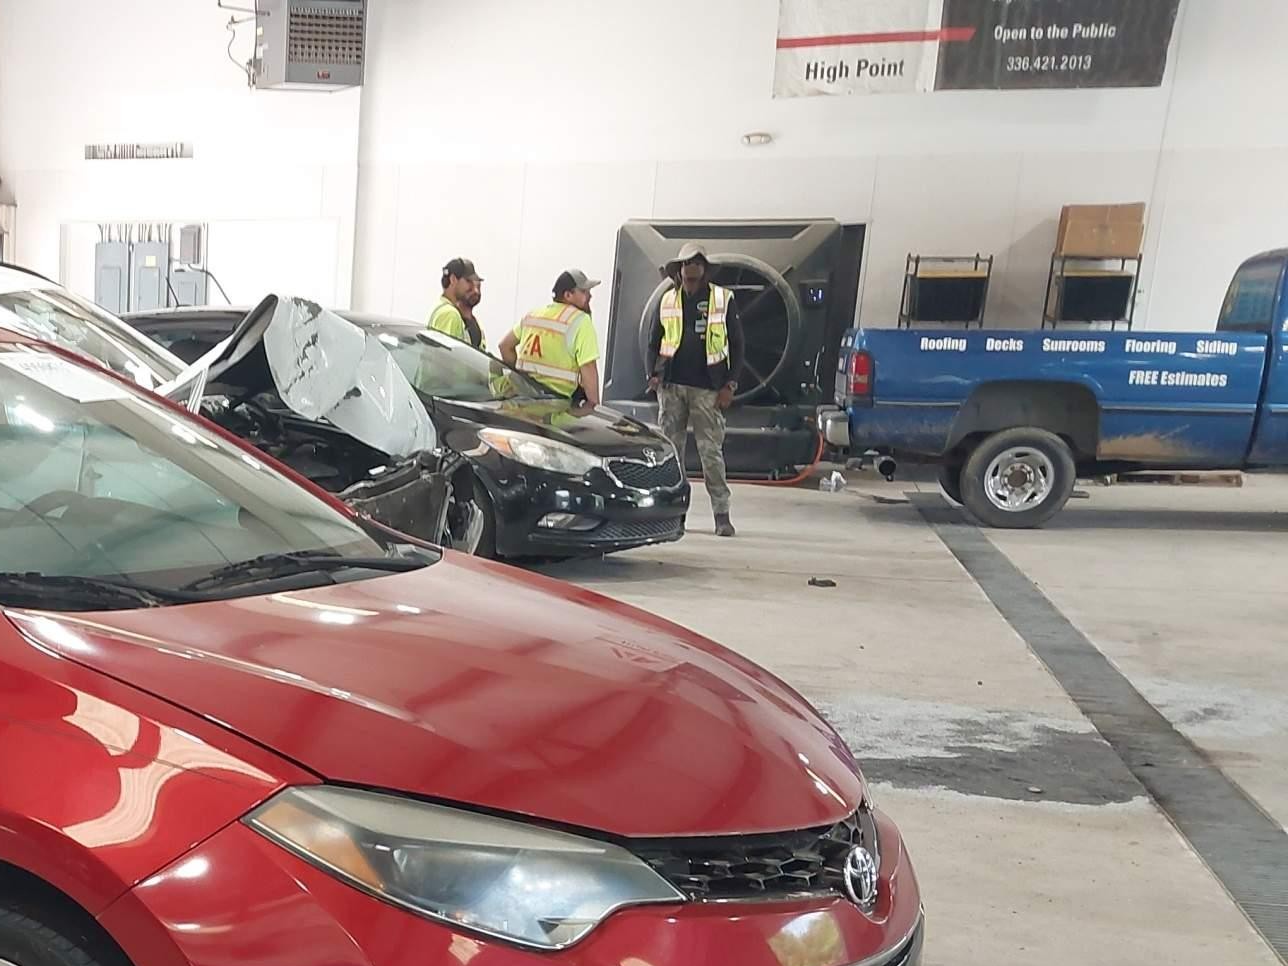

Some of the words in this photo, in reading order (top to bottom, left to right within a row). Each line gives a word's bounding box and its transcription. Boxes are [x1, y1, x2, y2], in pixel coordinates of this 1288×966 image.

[994, 25, 1027, 43] Open
[1030, 26, 1044, 40] to
[1047, 24, 1069, 39] the
[1072, 22, 1117, 39] Public
[805, 61, 849, 83] High
[856, 58, 904, 78] Point
[1006, 55, 1092, 71] 336.421.2013
[920, 337, 967, 351] Roofing
[986, 338, 1024, 352] Decks
[1042, 338, 1106, 353] Sunrooms
[1125, 339, 1177, 355] Flooring
[1196, 340, 1238, 356] Siding
[1128, 370, 1159, 385] FREE
[1160, 371, 1228, 387] Estimates
